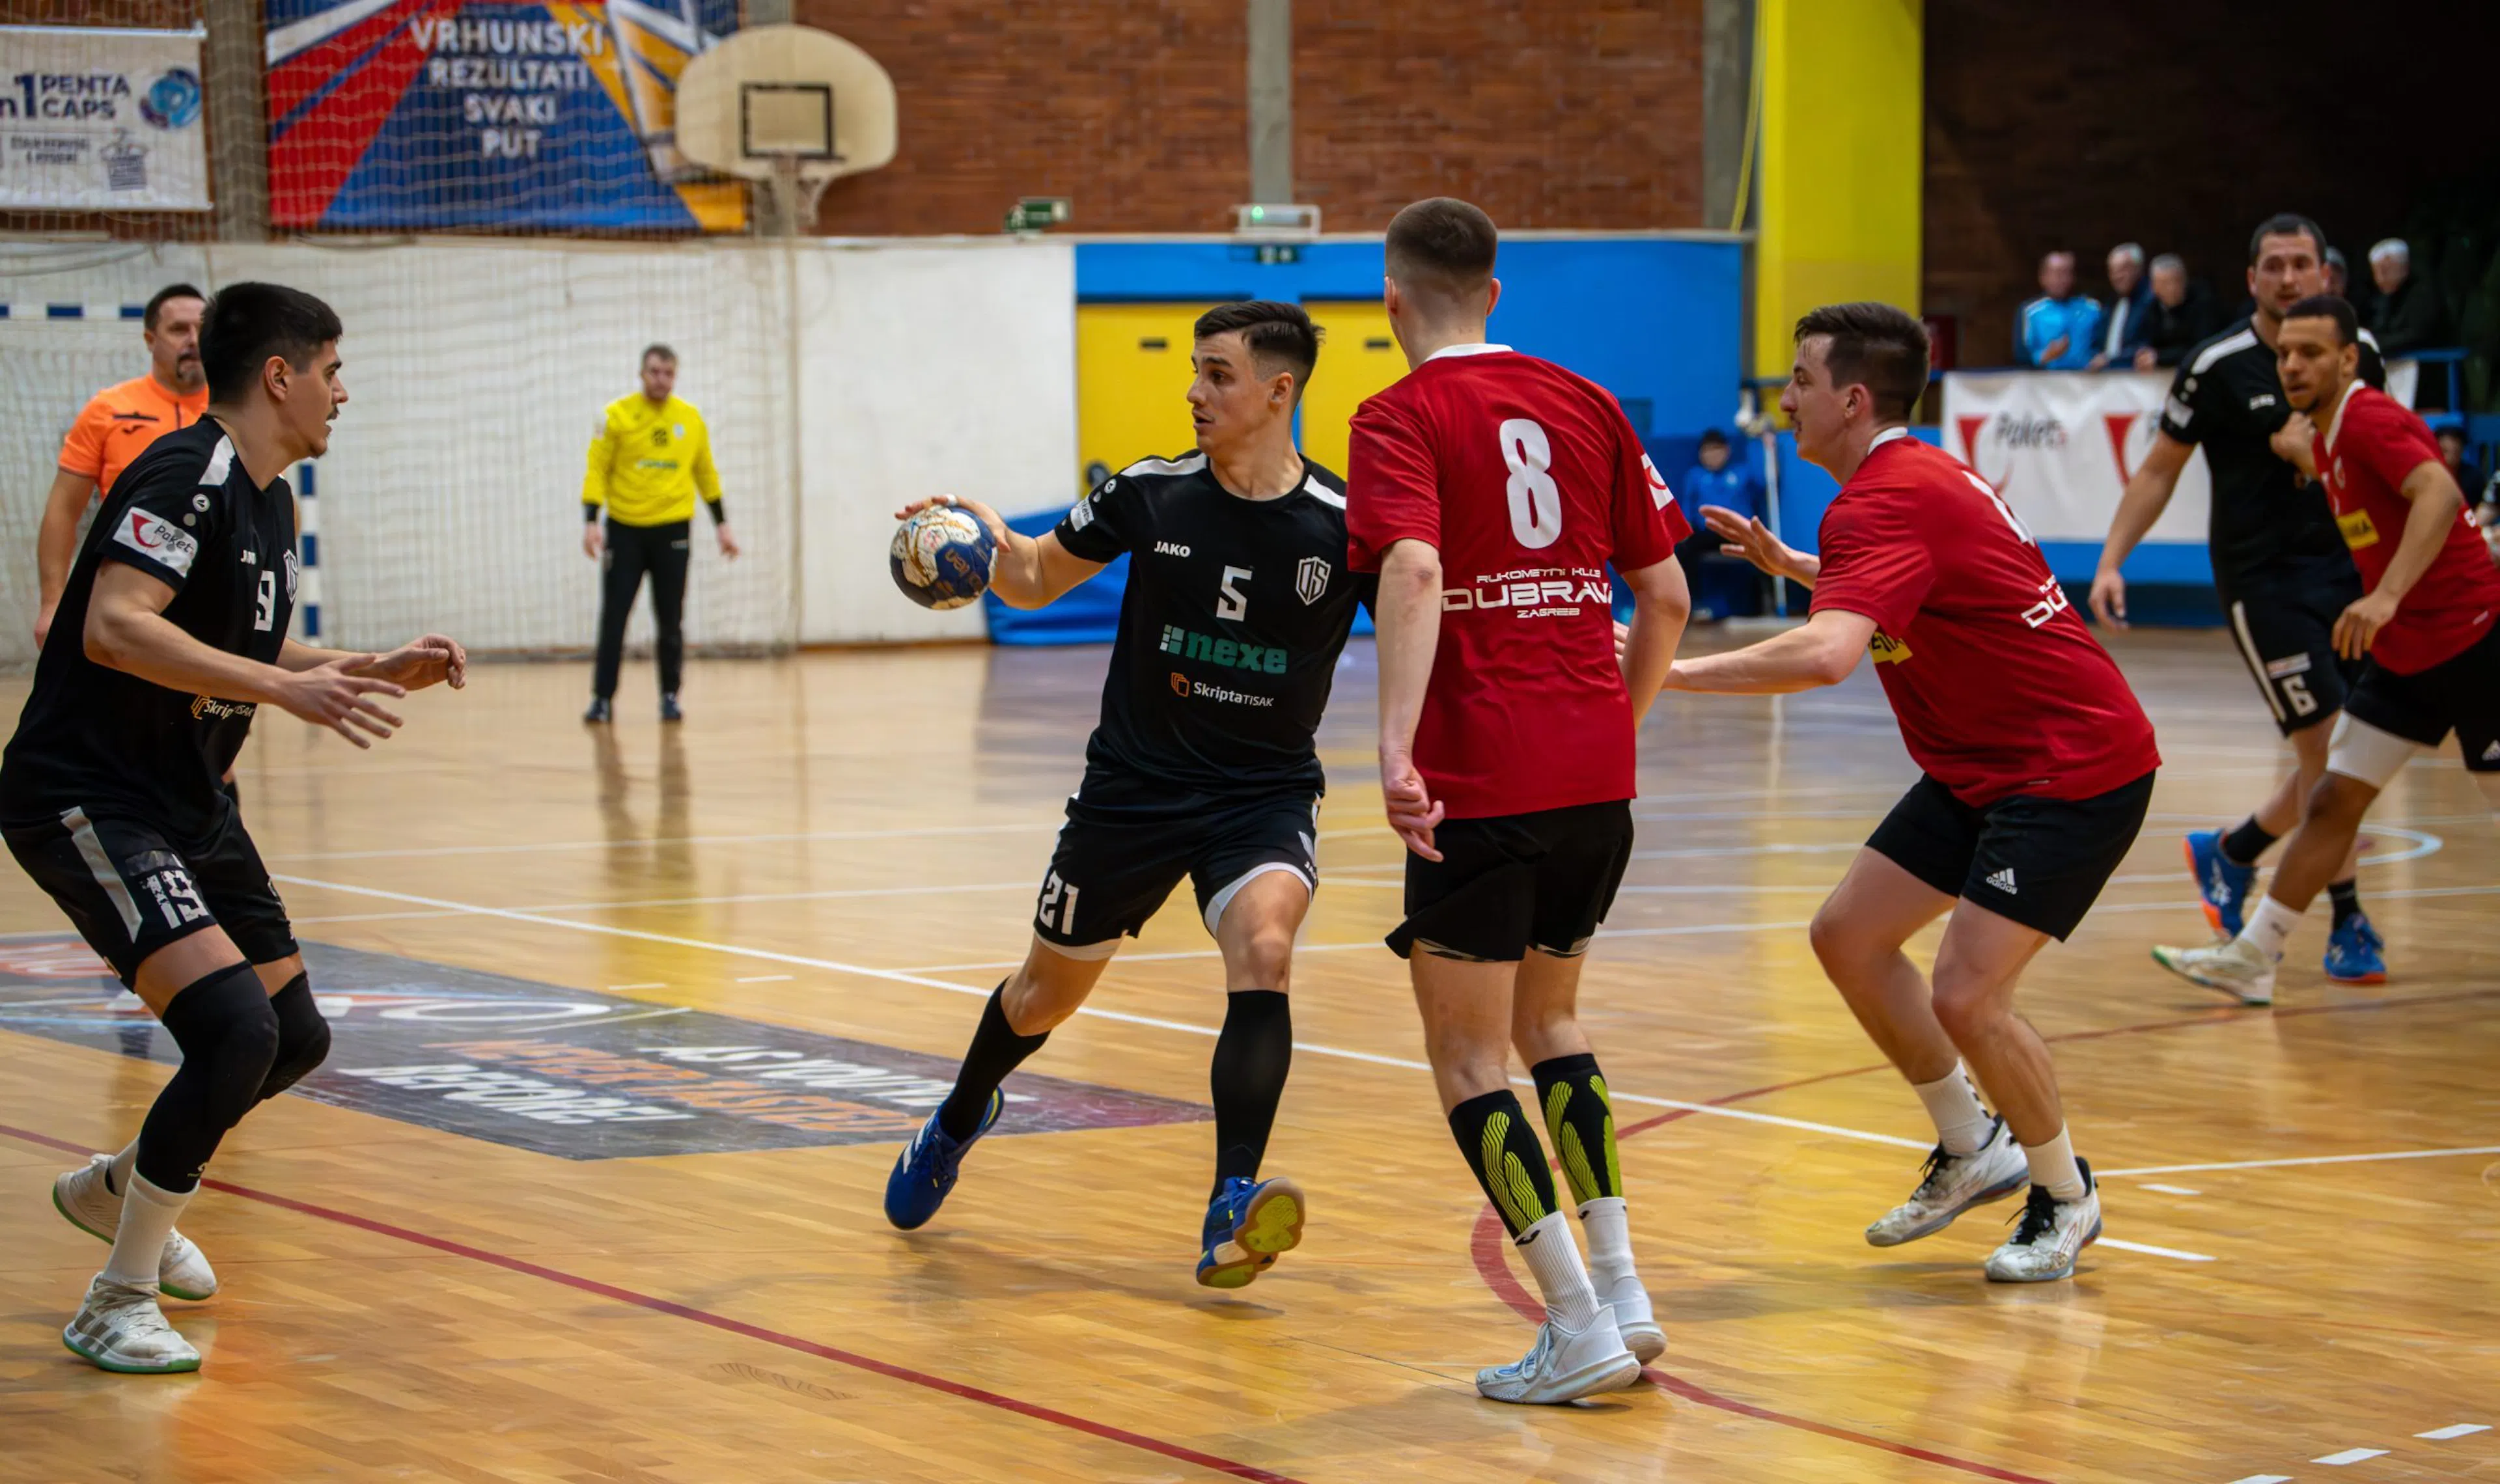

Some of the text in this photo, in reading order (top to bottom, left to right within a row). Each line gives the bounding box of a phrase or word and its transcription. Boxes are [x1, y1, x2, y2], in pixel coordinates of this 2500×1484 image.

[410, 18, 604, 55] VRHUNSKI
[40, 74, 131, 96] PENTA
[428, 57, 587, 89] REZULTATI
[43, 98, 117, 119] CAPS
[464, 94, 557, 124] SVAKI
[482, 130, 542, 159] PUT
[1499, 419, 1562, 549] 8
[1154, 541, 1191, 558] JAKO
[1477, 568, 1566, 584] RUKOMETNI
[1216, 565, 1253, 622] 5
[1517, 607, 1580, 618] ZAGREB
[1186, 631, 1287, 674] nexe
[2281, 673, 2319, 717] 6
[1986, 875, 2018, 896] adidas
[1038, 870, 1080, 935] 21
[336, 1064, 699, 1125] BEFORE!
